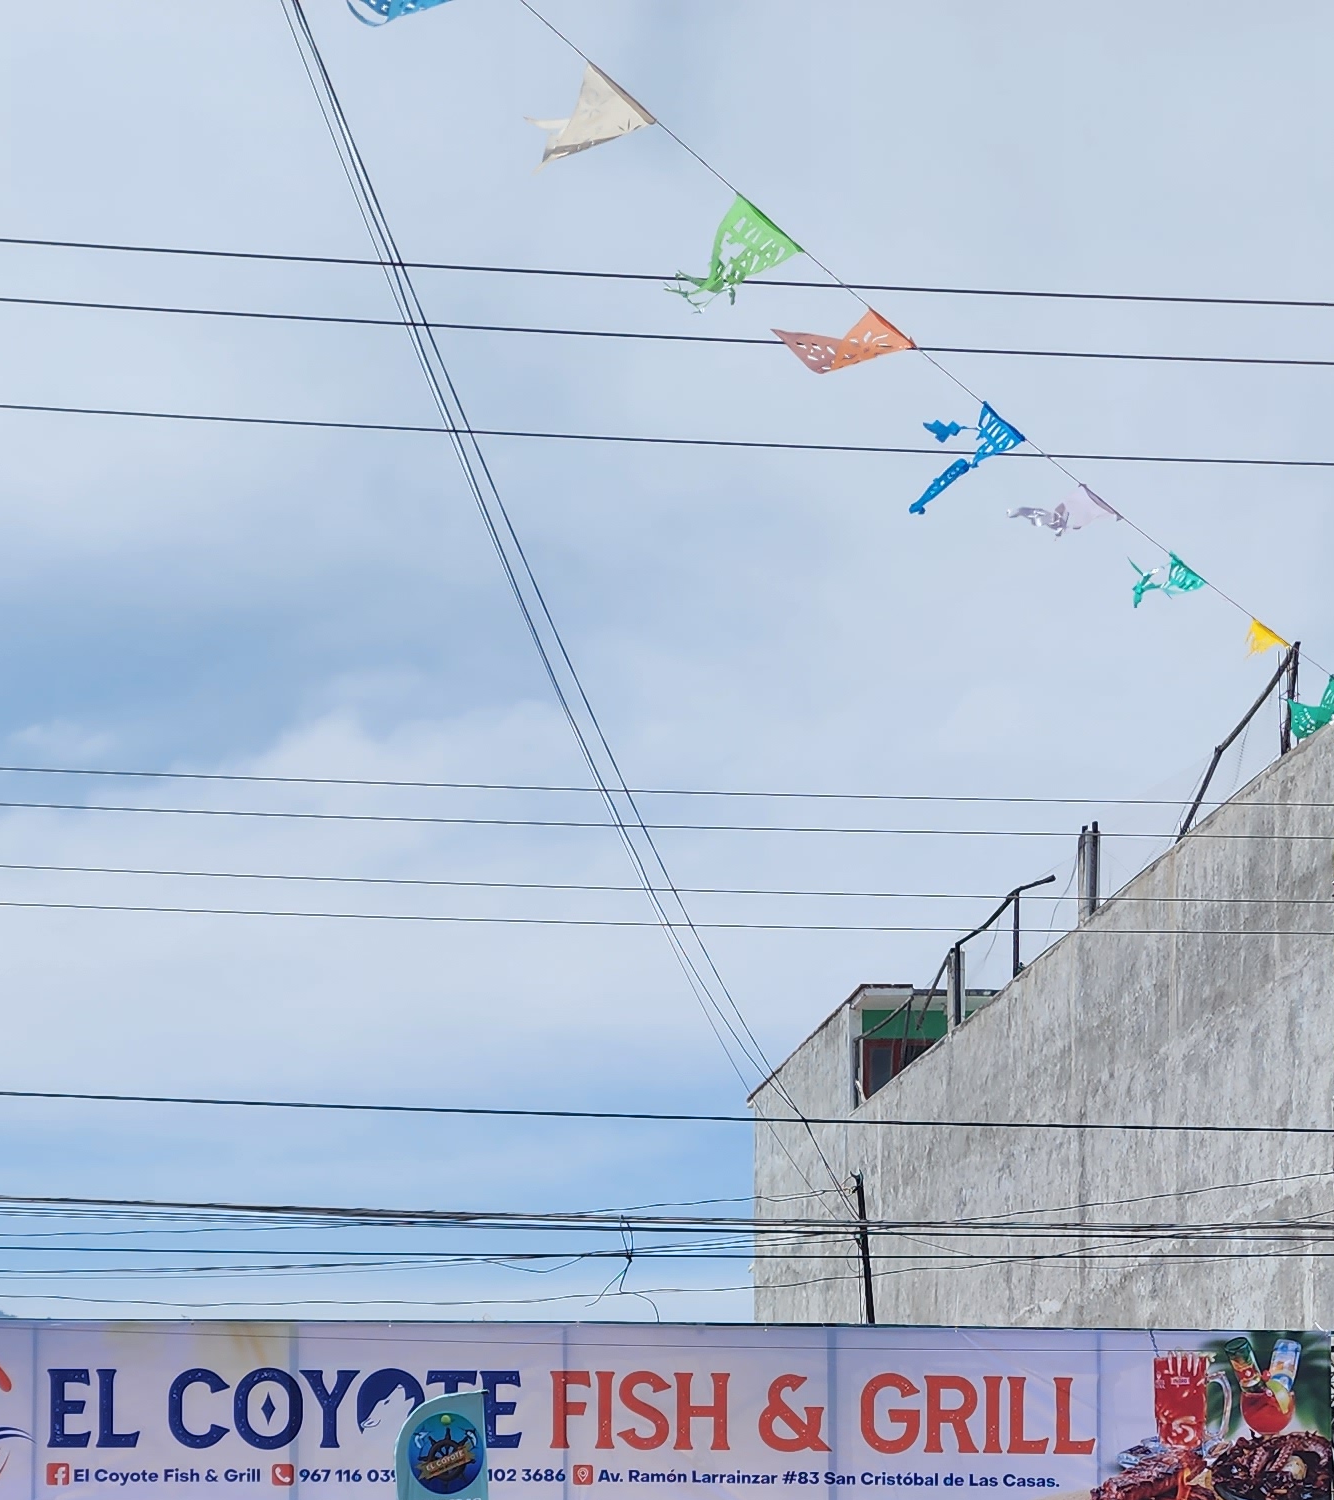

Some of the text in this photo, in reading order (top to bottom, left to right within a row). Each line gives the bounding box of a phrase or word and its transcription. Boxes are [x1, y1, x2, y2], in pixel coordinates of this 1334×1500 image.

[47, 1368, 140, 1449] EL
[549, 1370, 731, 1451] FISH
[758, 1373, 832, 1453] &
[859, 1373, 1096, 1455] GRILL
[74, 1468, 260, 1486] El Coyote Fish & Grill
[299, 1469, 331, 1482] 967
[335, 1469, 362, 1482] 116
[488, 1469, 565, 1482] 102 3686
[598, 1469, 1060, 1487] Av. Ramón Larrainzar #83 San Cristóbal de Las Casas.
